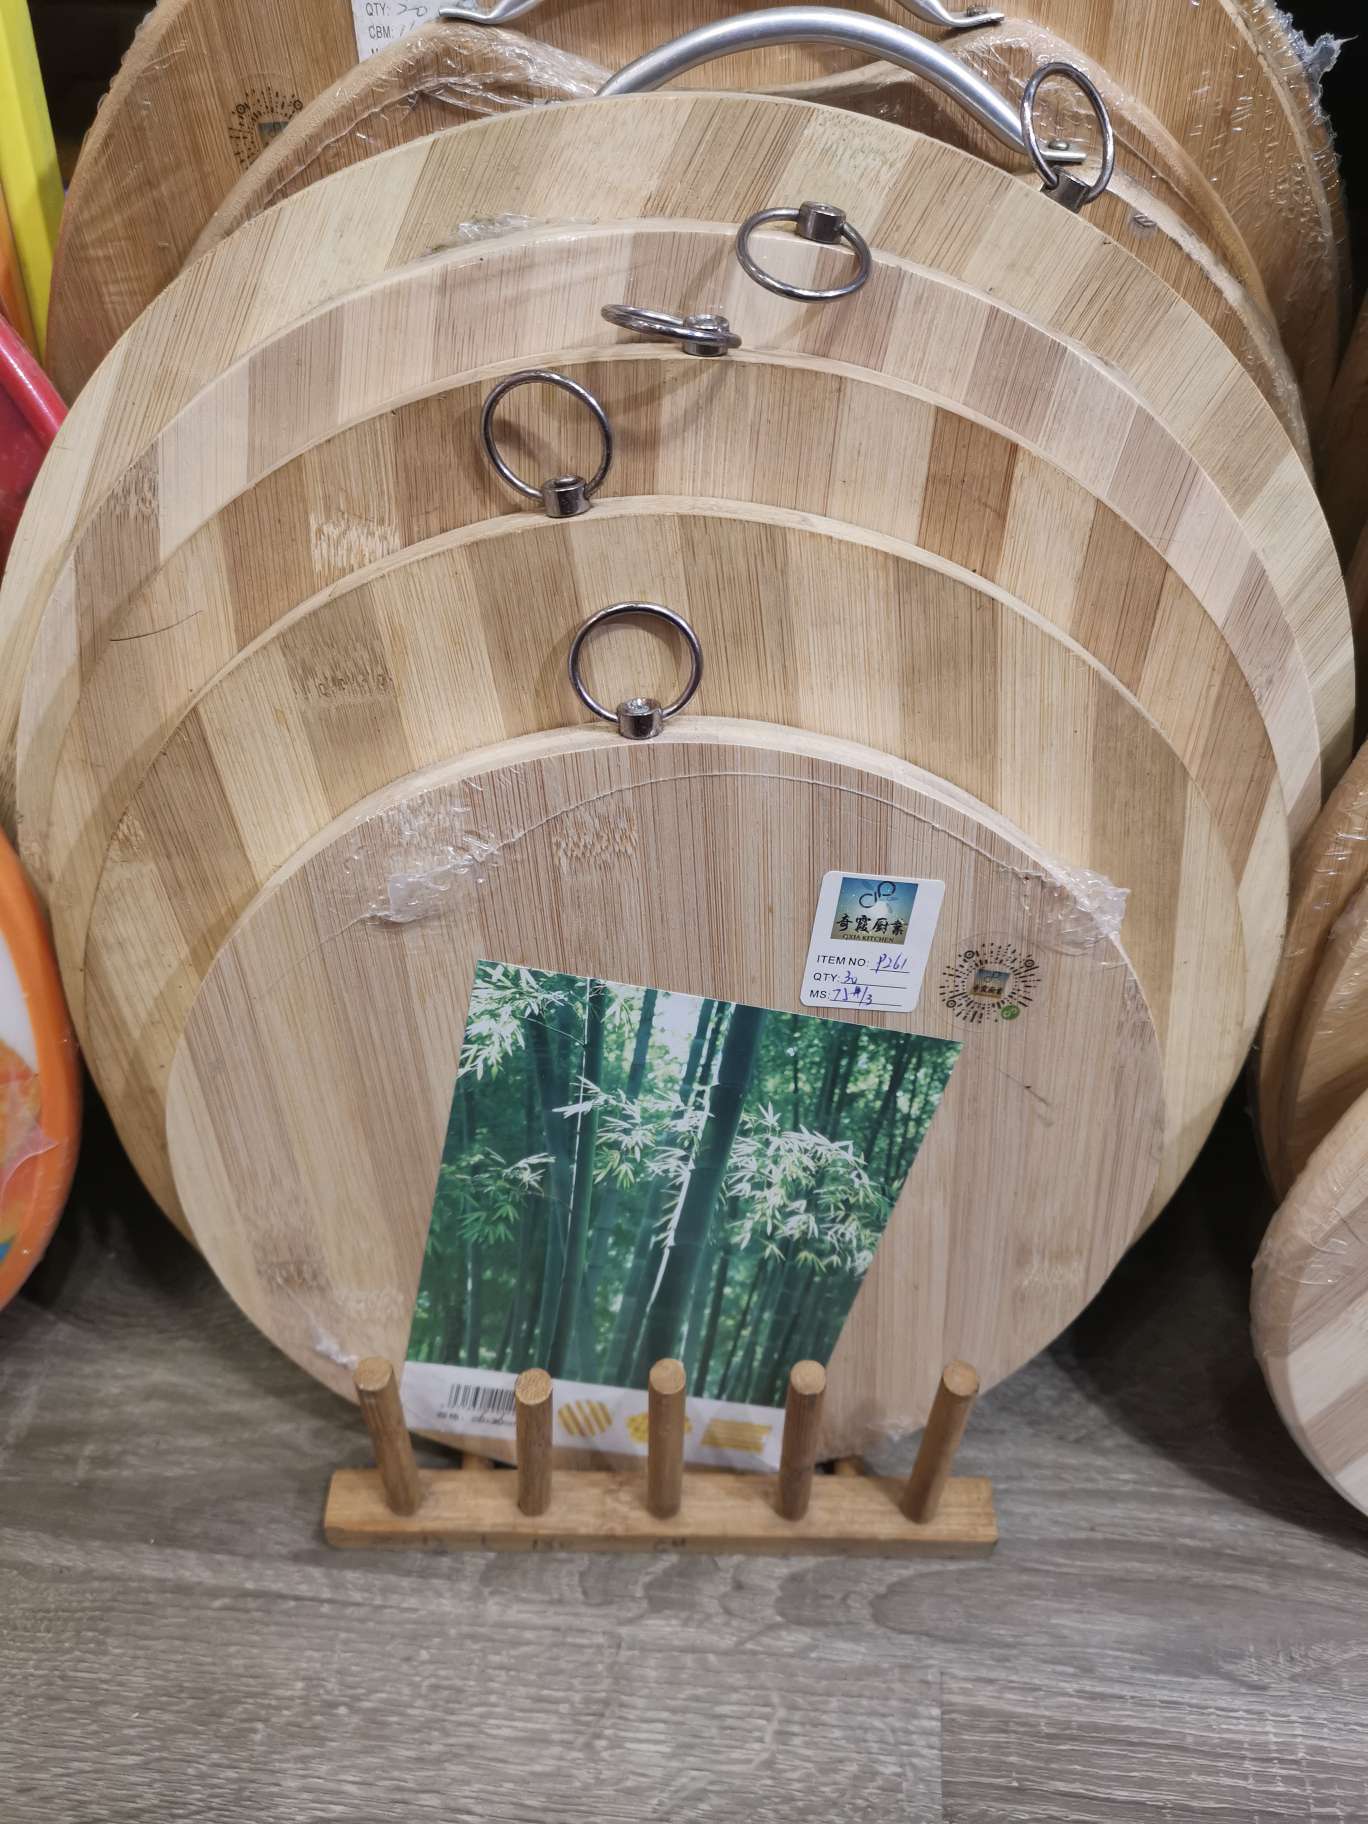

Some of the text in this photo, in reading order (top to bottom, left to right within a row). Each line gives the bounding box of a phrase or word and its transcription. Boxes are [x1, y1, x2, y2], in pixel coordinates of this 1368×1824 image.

[365, 2, 391, 17] QTY:
[368, 25, 394, 39] CBM:
[862, 935, 895, 944] KITCHEN
[816, 954, 846, 966] ITEM
[848, 958, 870, 968] NO:
[813, 972, 840, 983] QTY:
[809, 989, 831, 1000] MS:
